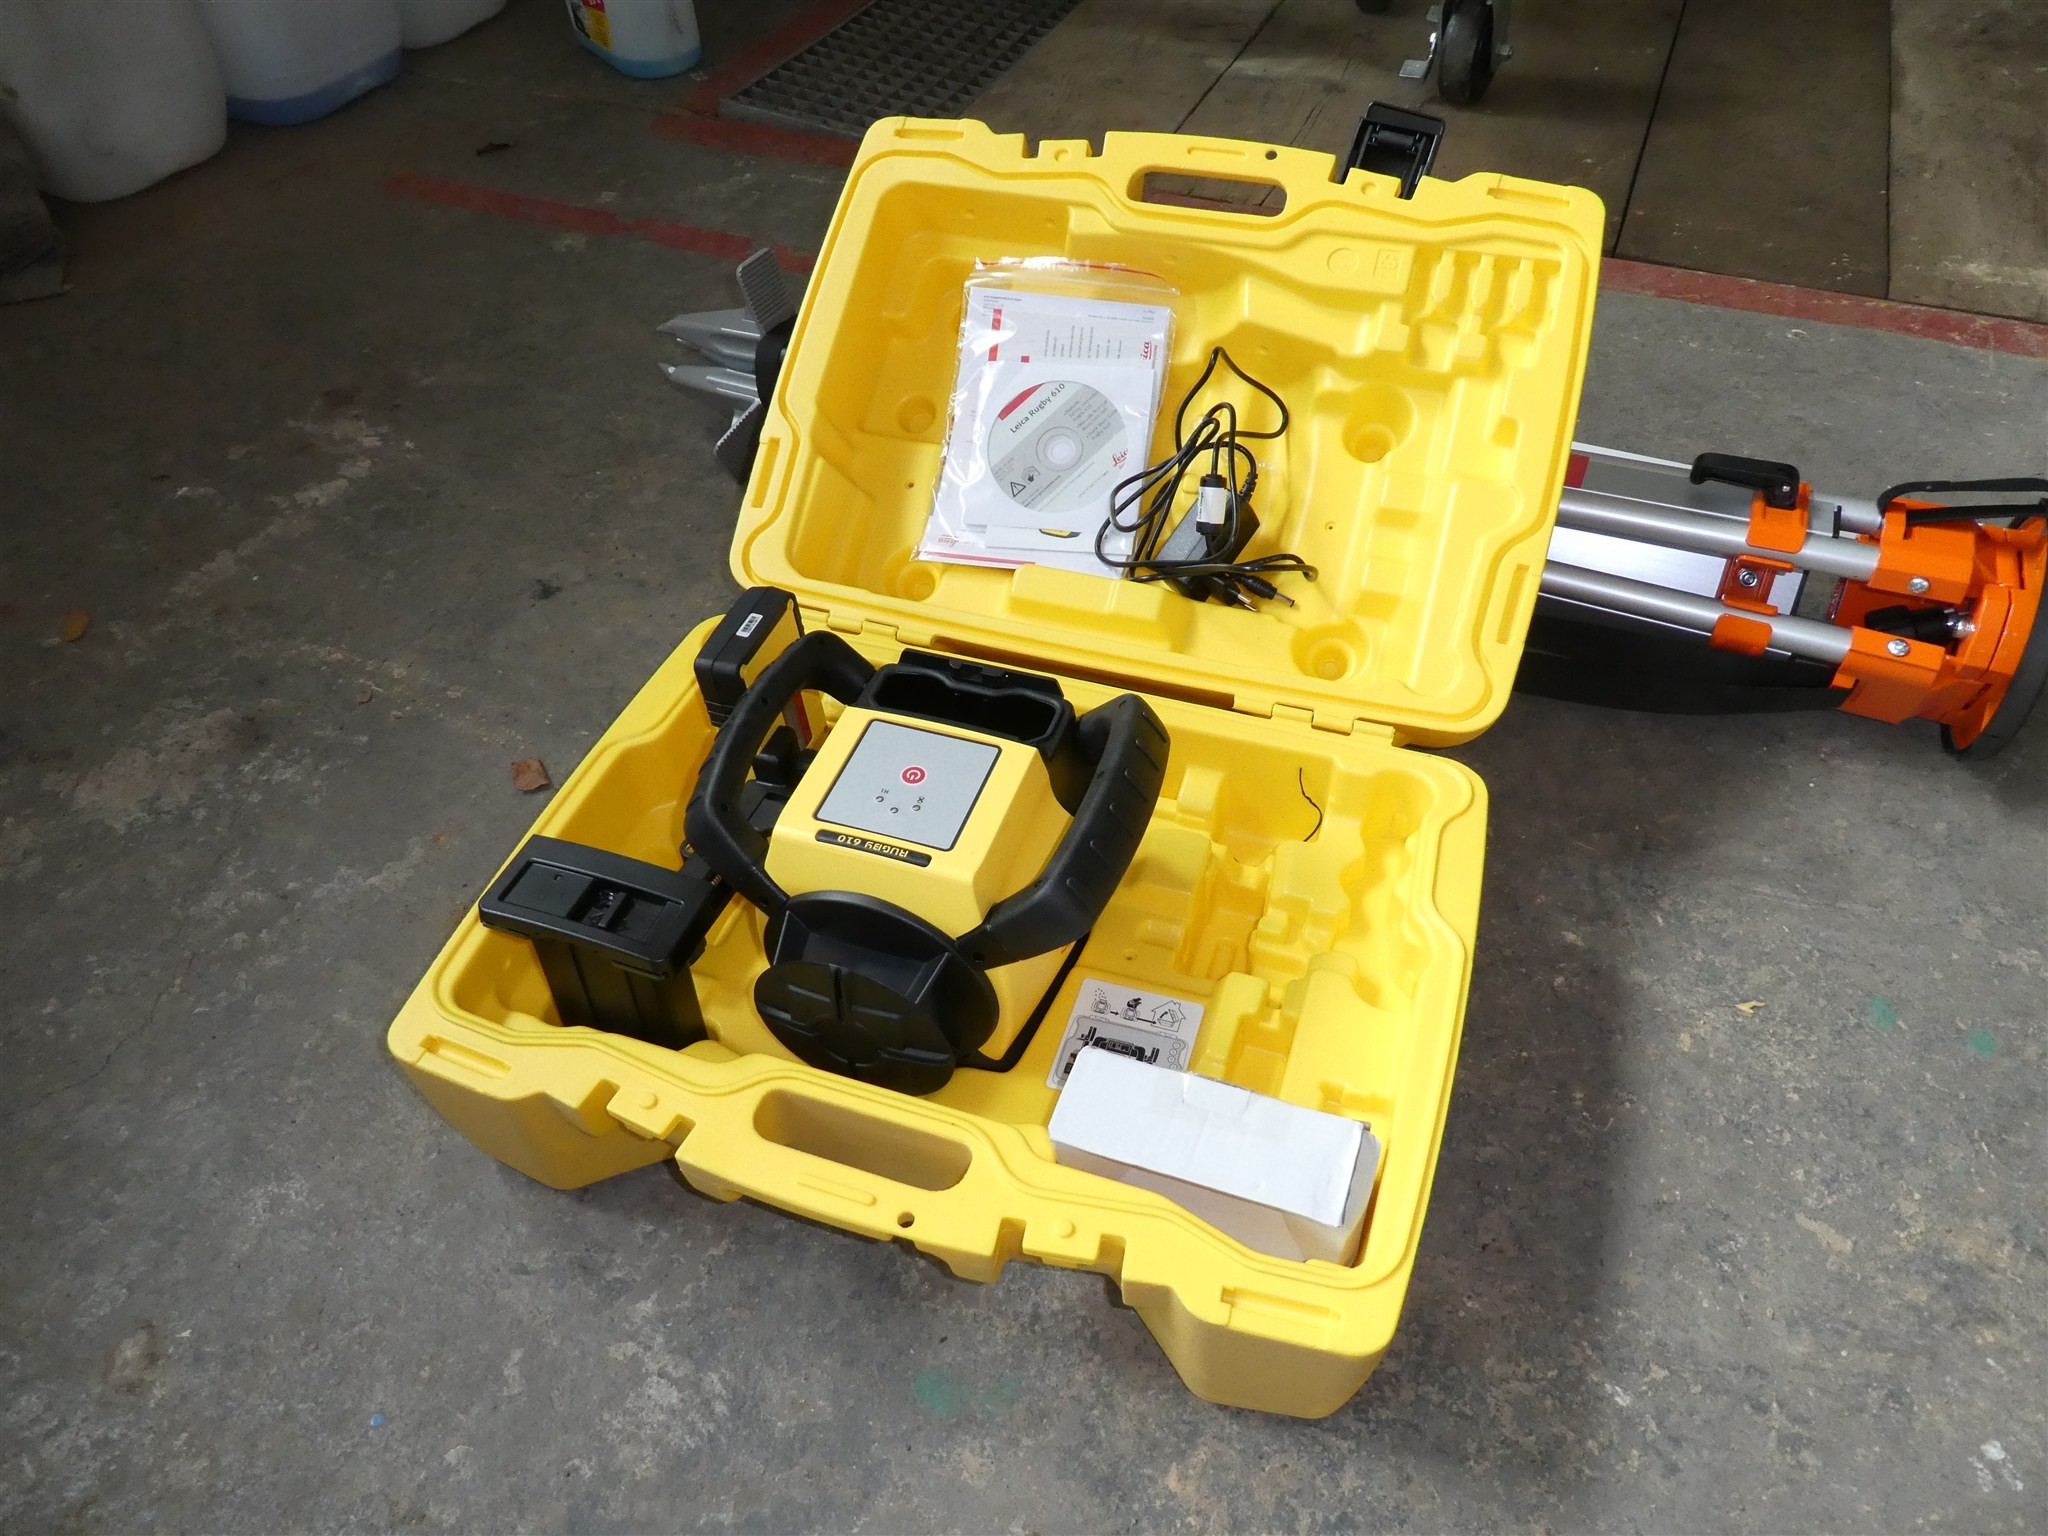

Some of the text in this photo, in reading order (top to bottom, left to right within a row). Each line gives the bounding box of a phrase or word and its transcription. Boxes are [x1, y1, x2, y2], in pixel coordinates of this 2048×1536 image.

[1140, 341, 1152, 360] ica
[1010, 416, 1030, 434] Leica
[1028, 396, 1052, 417] Rugby
[1051, 383, 1066, 397] 610
[1112, 448, 1129, 467] Leic
[837, 834, 909, 858] RUGBY 610
